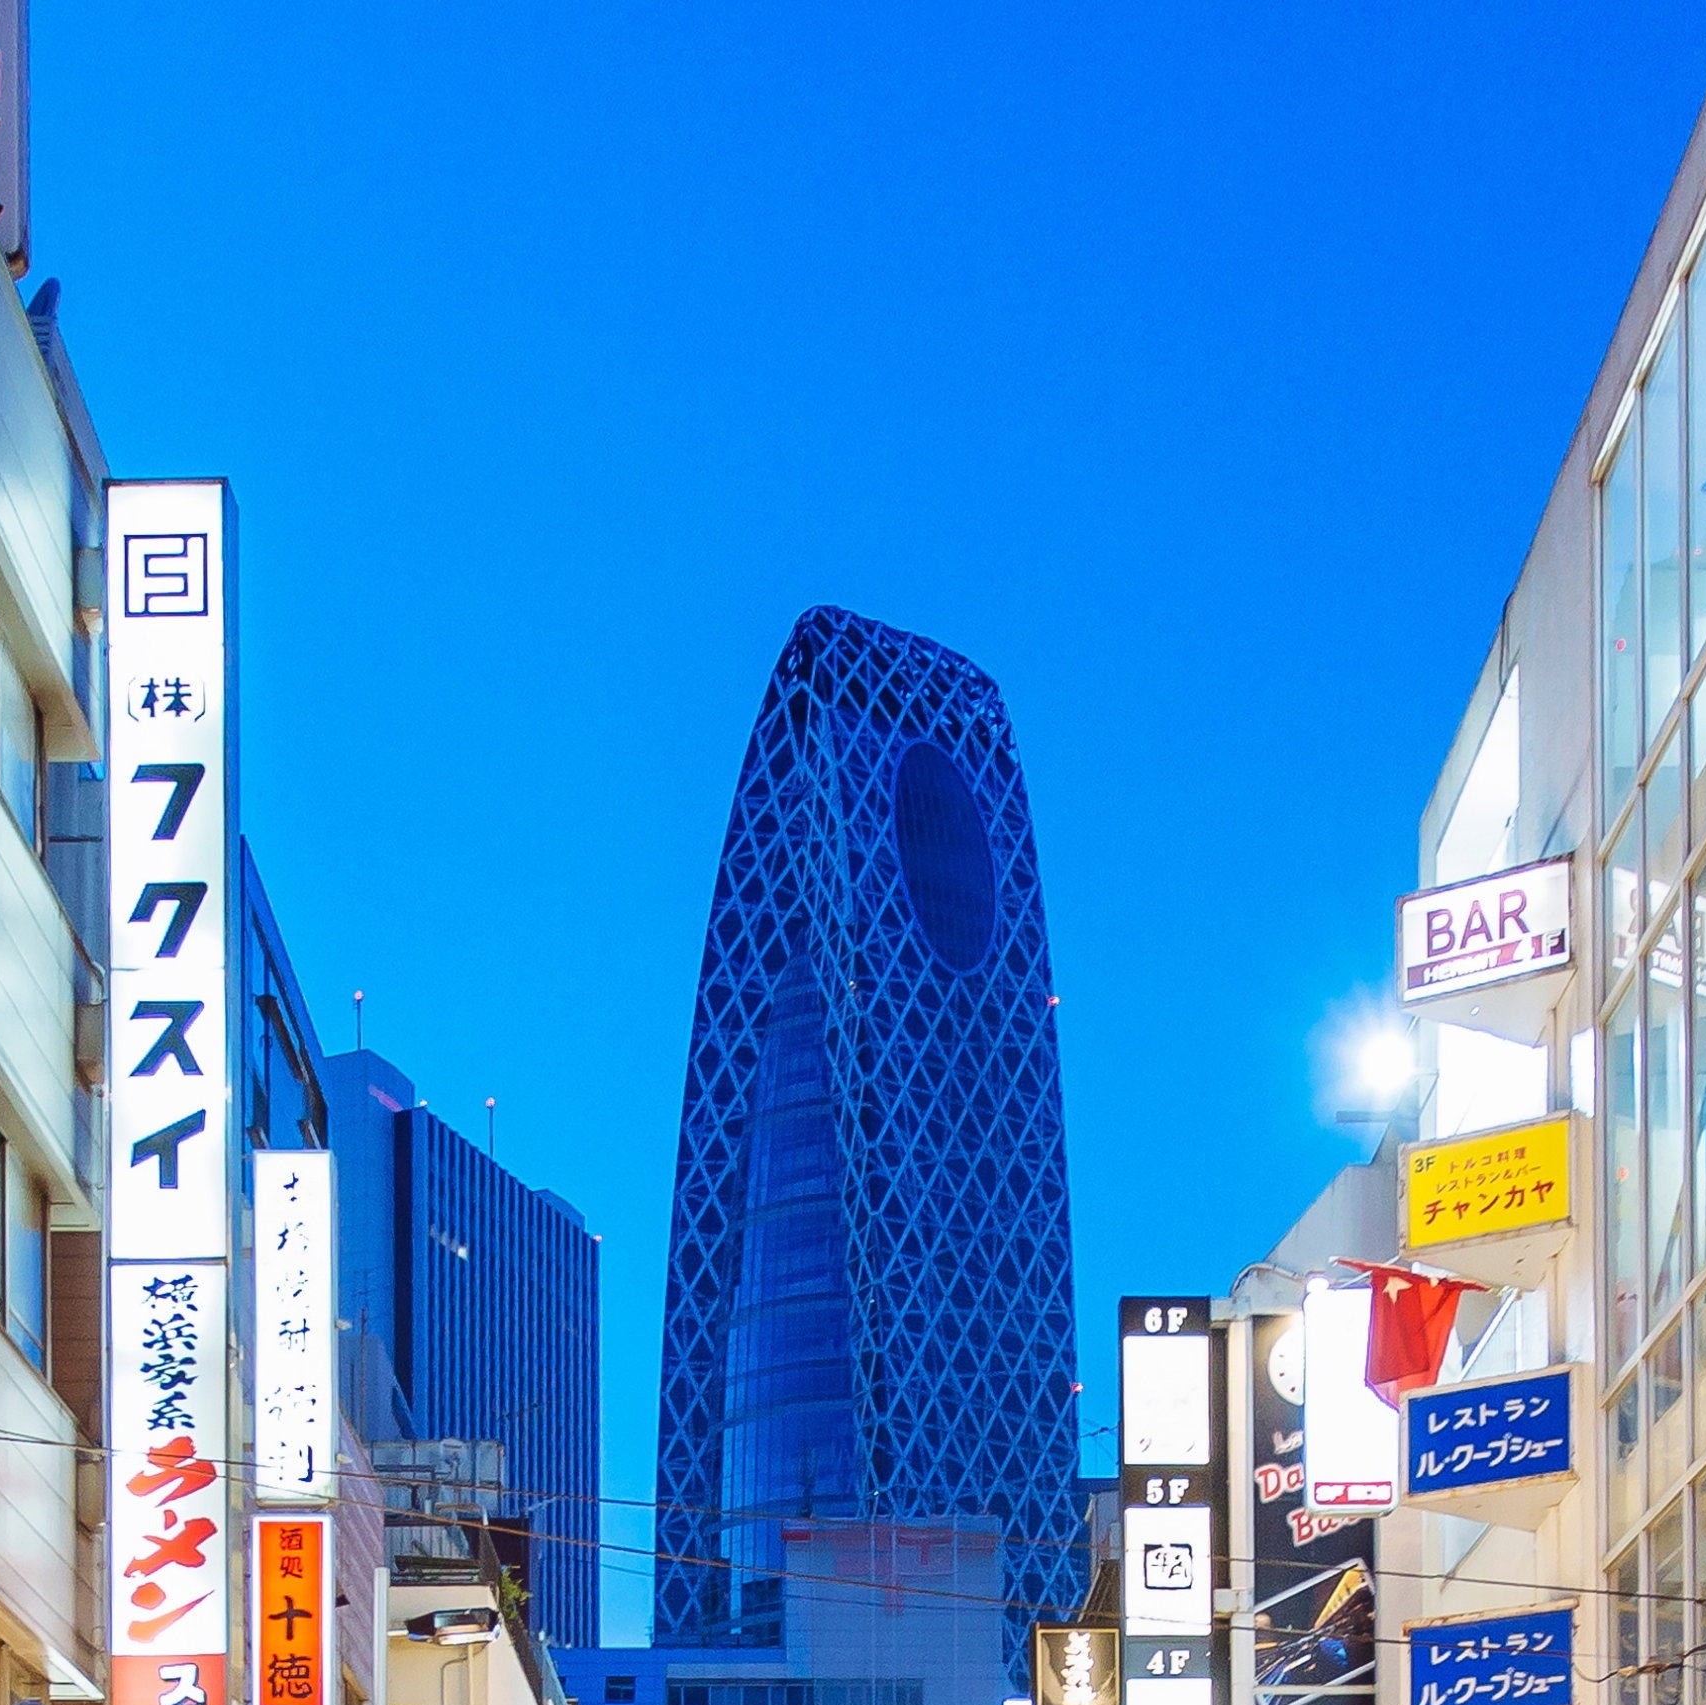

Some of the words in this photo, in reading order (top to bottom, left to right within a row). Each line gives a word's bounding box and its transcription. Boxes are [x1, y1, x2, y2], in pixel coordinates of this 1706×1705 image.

[1427, 889, 1531, 957] BAR
[129, 763, 209, 1190] フクスイ
[1415, 1153, 1437, 1174] 3F
[1449, 1147, 1528, 1174] トルコ料理
[1423, 1179, 1555, 1225] チャンカヤ
[1144, 1308, 1188, 1334] 6F
[140, 1273, 200, 1432] 横浜家系
[1428, 1398, 1550, 1434] レストラン
[1146, 1479, 1190, 1504] 5F
[123, 1435, 218, 1643] ラーメン
[268, 1597, 314, 1700] 十徳
[1146, 1651, 1190, 1675] 4F
[1430, 1633, 1553, 1667] レストラン
